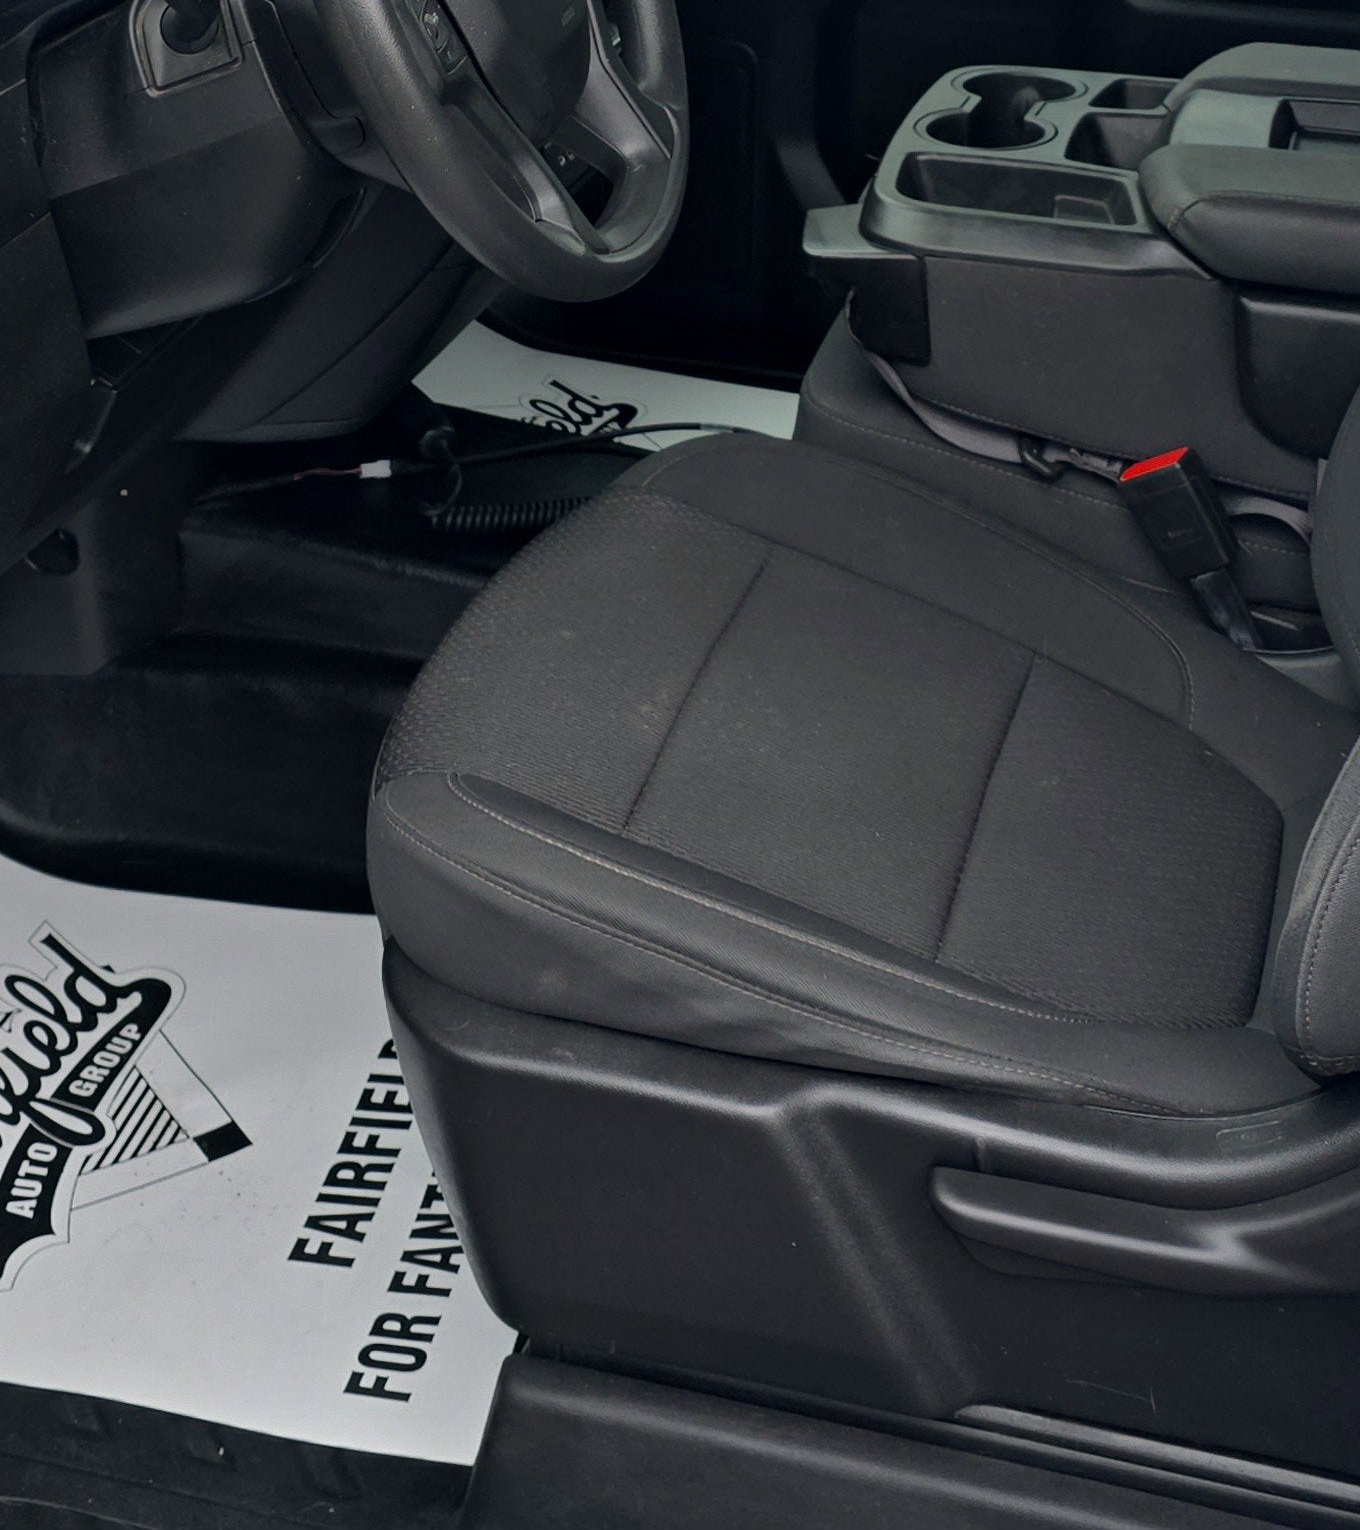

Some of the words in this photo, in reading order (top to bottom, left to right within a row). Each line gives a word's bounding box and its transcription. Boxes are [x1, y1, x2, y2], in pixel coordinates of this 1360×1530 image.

[4, 1141, 59, 1220] AUTO
[67, 1022, 142, 1098] GROUP
[287, 1037, 415, 1269] FAIRFIEL
[342, 1311, 442, 1403] FOR
